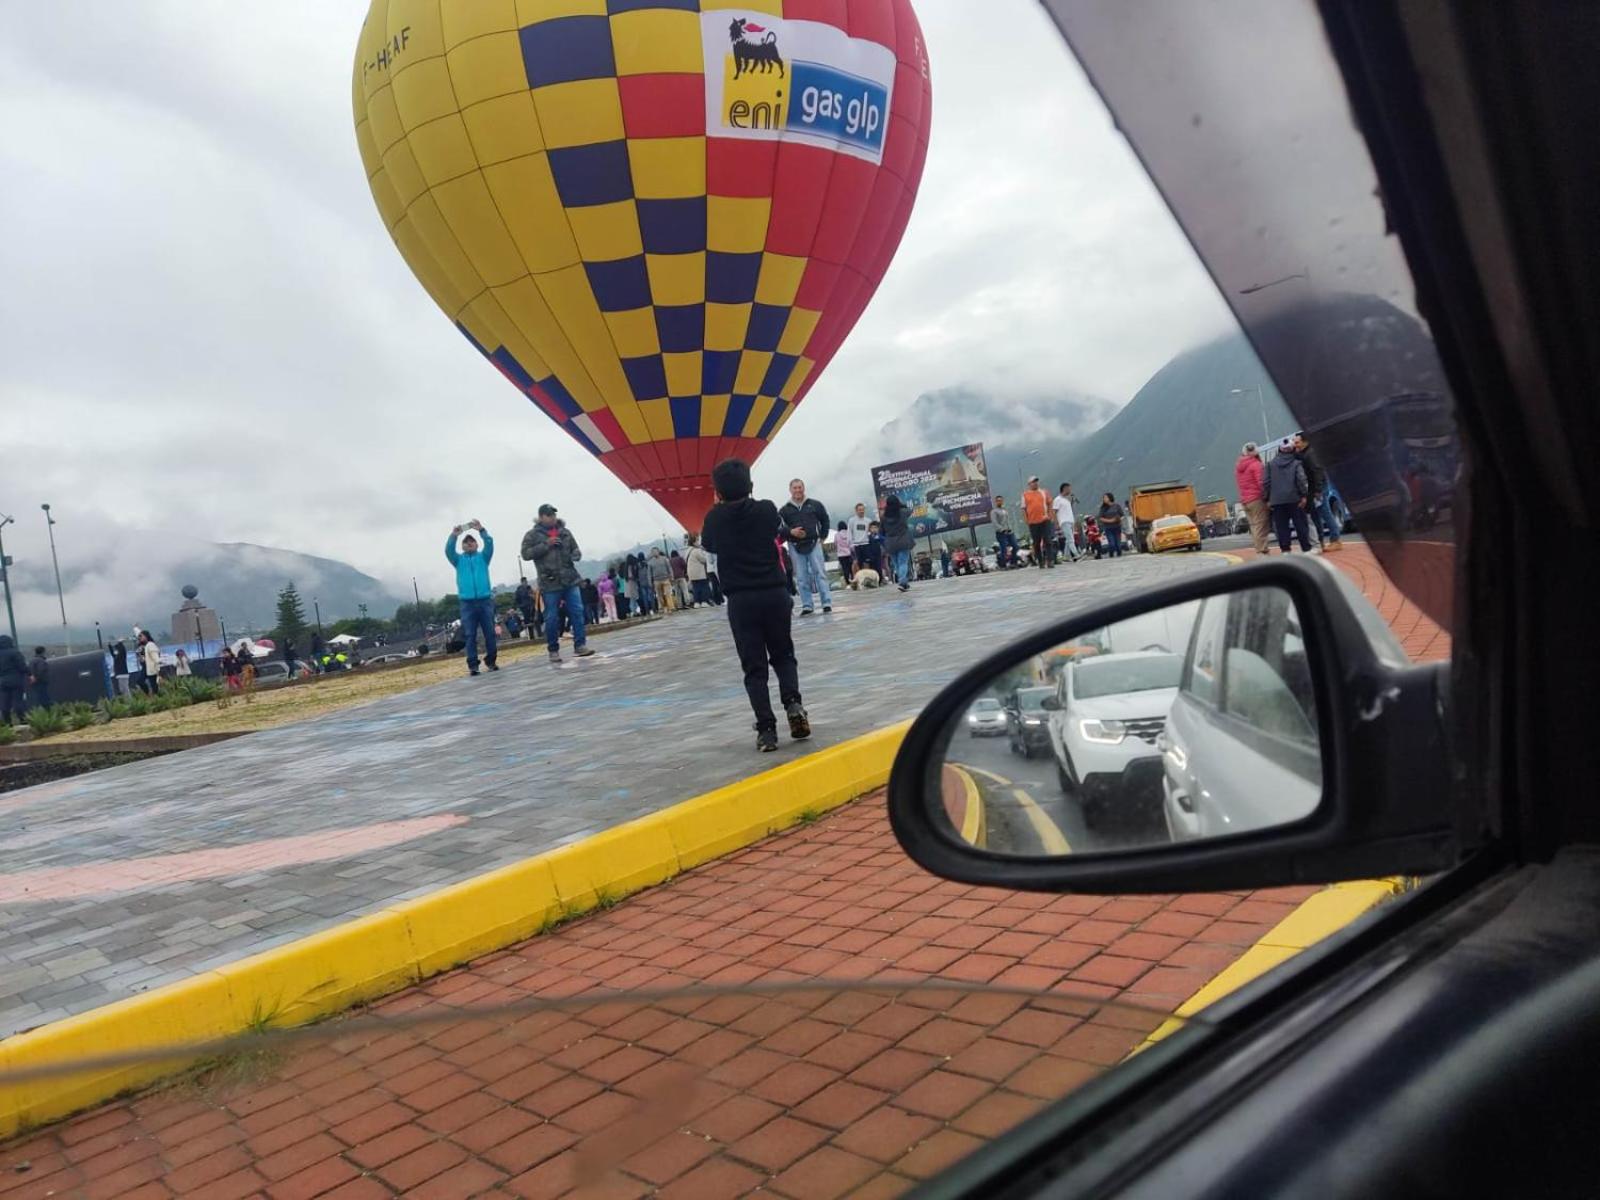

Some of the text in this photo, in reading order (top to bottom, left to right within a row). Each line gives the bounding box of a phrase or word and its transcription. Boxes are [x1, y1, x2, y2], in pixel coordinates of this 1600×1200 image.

[729, 90, 783, 130] eni
[802, 86, 879, 139] gas glp
